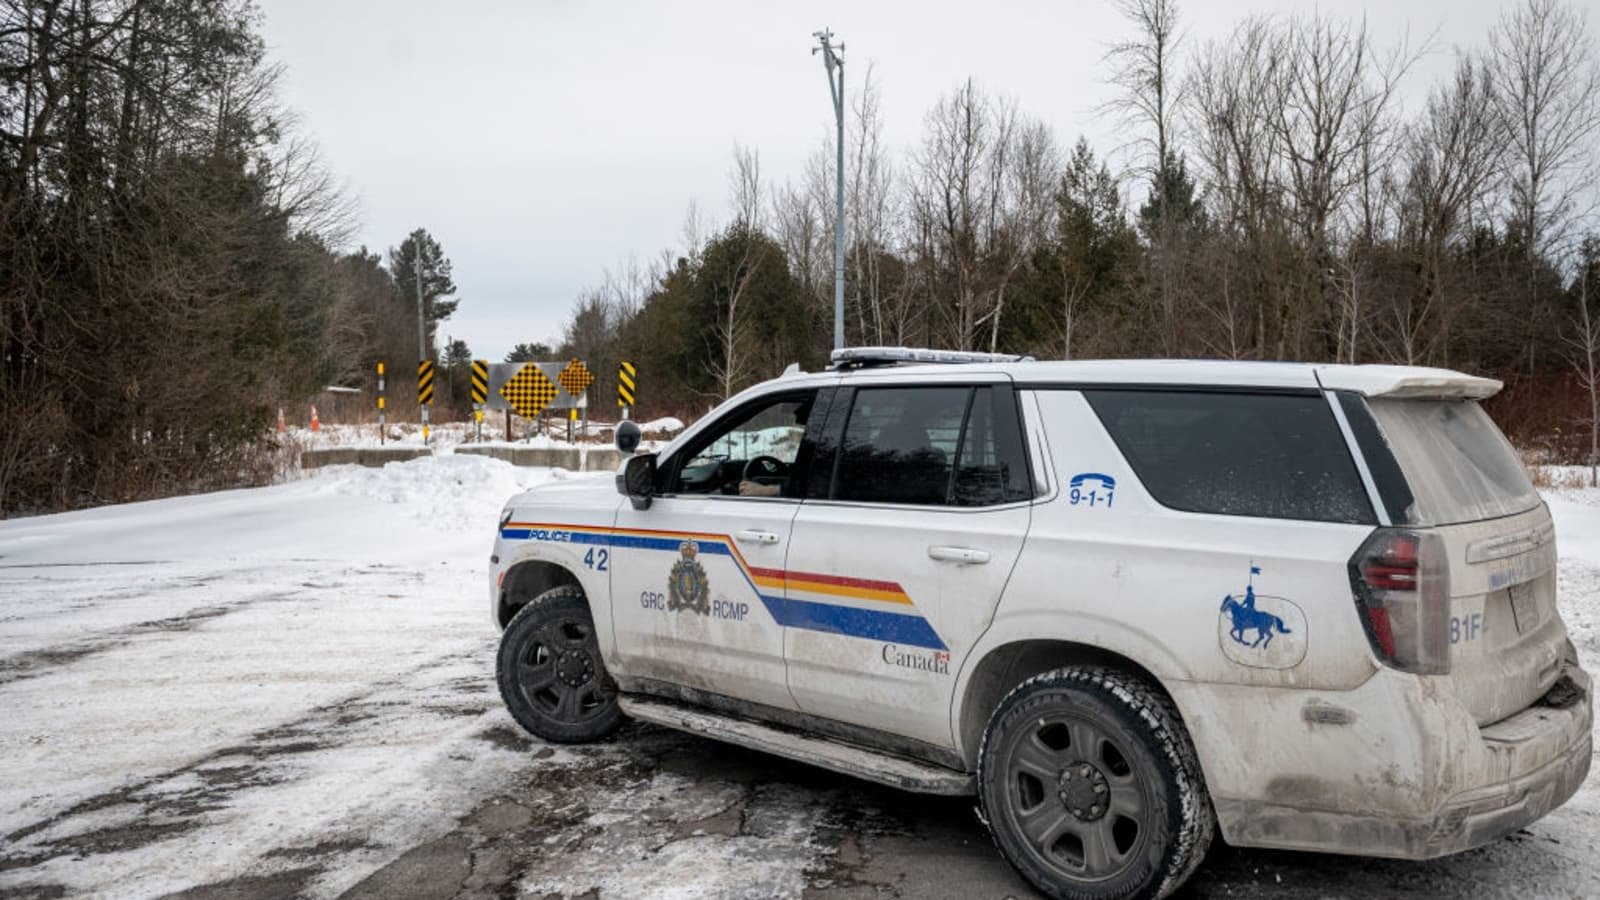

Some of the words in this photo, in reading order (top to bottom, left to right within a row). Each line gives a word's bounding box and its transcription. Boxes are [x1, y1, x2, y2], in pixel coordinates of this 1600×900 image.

[1070, 488, 1113, 508] 9-1-1
[529, 530, 570, 542] POLICE
[583, 547, 608, 571] 42
[640, 591, 666, 610] GRC
[712, 600, 749, 621] RCMP
[882, 643, 950, 675] Canada
